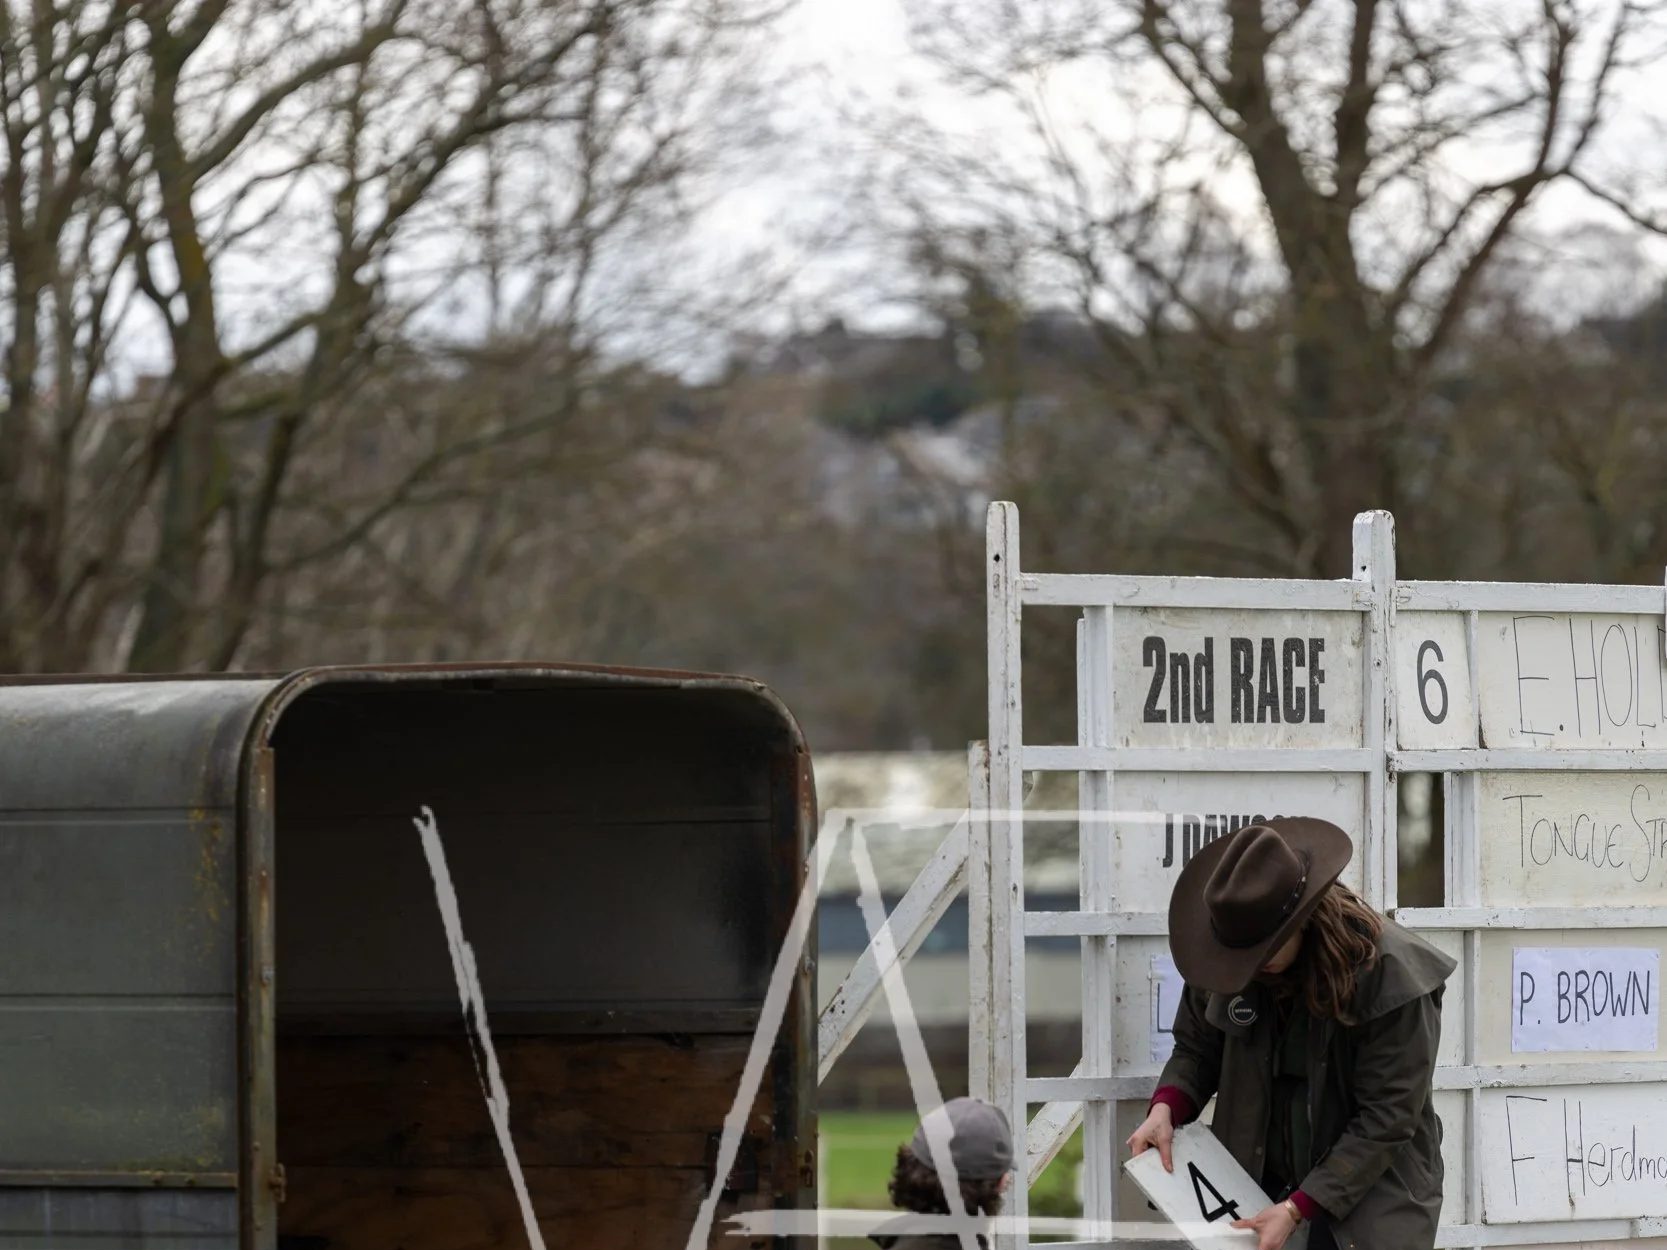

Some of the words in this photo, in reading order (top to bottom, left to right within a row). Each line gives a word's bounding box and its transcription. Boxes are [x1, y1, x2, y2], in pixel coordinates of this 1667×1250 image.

[1143, 636, 1214, 723] 2nd
[1230, 637, 1325, 723] RACE
[1416, 639, 1449, 724] 6
[1520, 971, 1541, 1026] P.
[1557, 970, 1650, 1024] BROWN
[1187, 1161, 1242, 1223] 4
[1506, 1095, 1547, 1207] F
